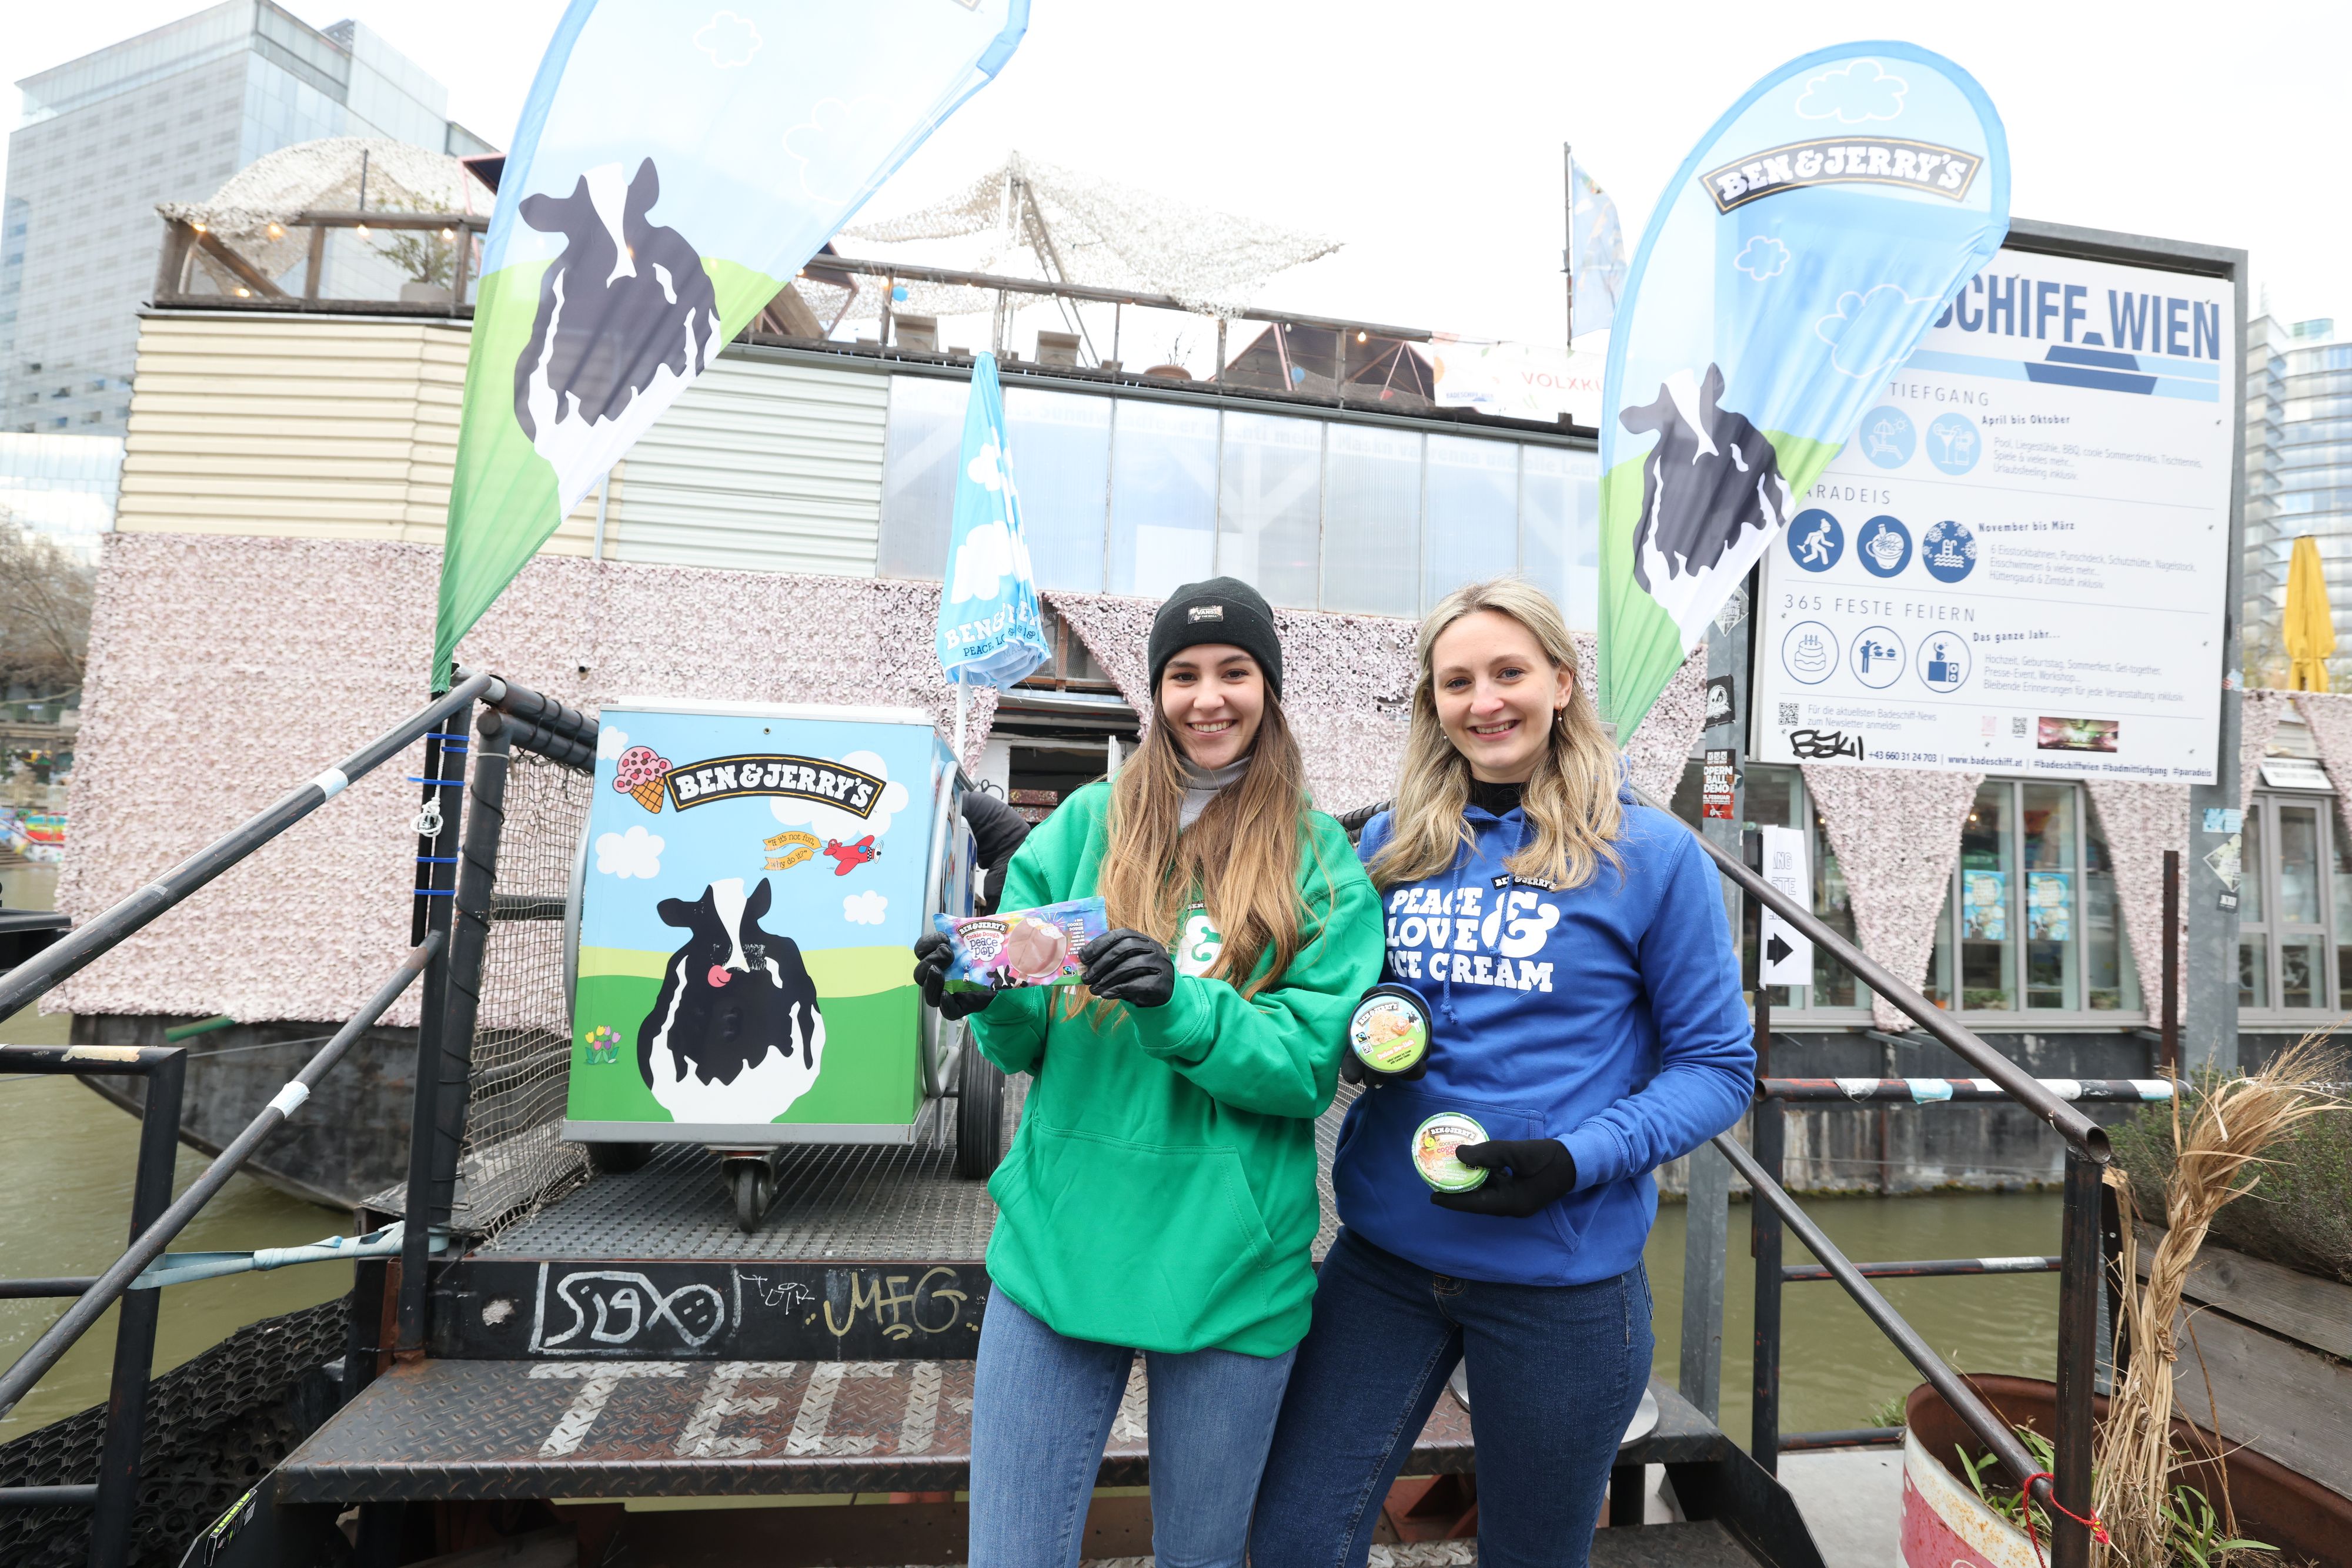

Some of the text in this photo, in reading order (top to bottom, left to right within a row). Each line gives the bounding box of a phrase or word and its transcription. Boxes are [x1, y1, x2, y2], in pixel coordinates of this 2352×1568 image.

[2108, 289, 2220, 360] WIEN
[1890, 382, 1989, 406] TIEFGANG
[1982, 414, 2070, 426] April bis Oktober
[1979, 520, 2074, 532] November bis März
[1785, 594, 1975, 622] 365 FESTE FEIERN
[1973, 629, 2060, 643] Das ganze Jahr...
[964, 642, 994, 657] PEACE,
[1983, 679, 2020, 691] Bleibende
[2023, 681, 2072, 696] Erinnerungen
[2105, 688, 2156, 702] Veranstaltung
[1808, 704, 1820, 714] Für
[1823, 706, 1833, 715] die
[1877, 709, 1937, 721] Badeschiff-News
[1825, 717, 1863, 728] Newsletter
[1866, 720, 1901, 730] anmelden
[1703, 765, 1733, 775] OPERN
[1868, 751, 1883, 760] +43
[1885, 751, 1899, 760] 660
[1902, 752, 1910, 761] 31
[1912, 752, 1922, 761] 24
[1923, 753, 1937, 762] 703
[1947, 755, 2023, 767] www.badeschiff.at
[2034, 759, 2099, 772] #badeschiffwien
[2173, 767, 2212, 778] #paradeis
[1706, 775, 1728, 784] BALL
[1703, 784, 1730, 793] DEMO
[779, 835, 787, 844] it's
[803, 834, 814, 846] fun,
[770, 860, 785, 869] why
[787, 856, 796, 865] do
[1389, 887, 1560, 958] PEACE &
[1386, 917, 1479, 951] LOVE
[970, 938, 998, 950] peace
[974, 947, 995, 958] pop
[1388, 950, 1554, 992] ICE CREAM
[1377, 1039, 1415, 1059] Dulce De-lish
